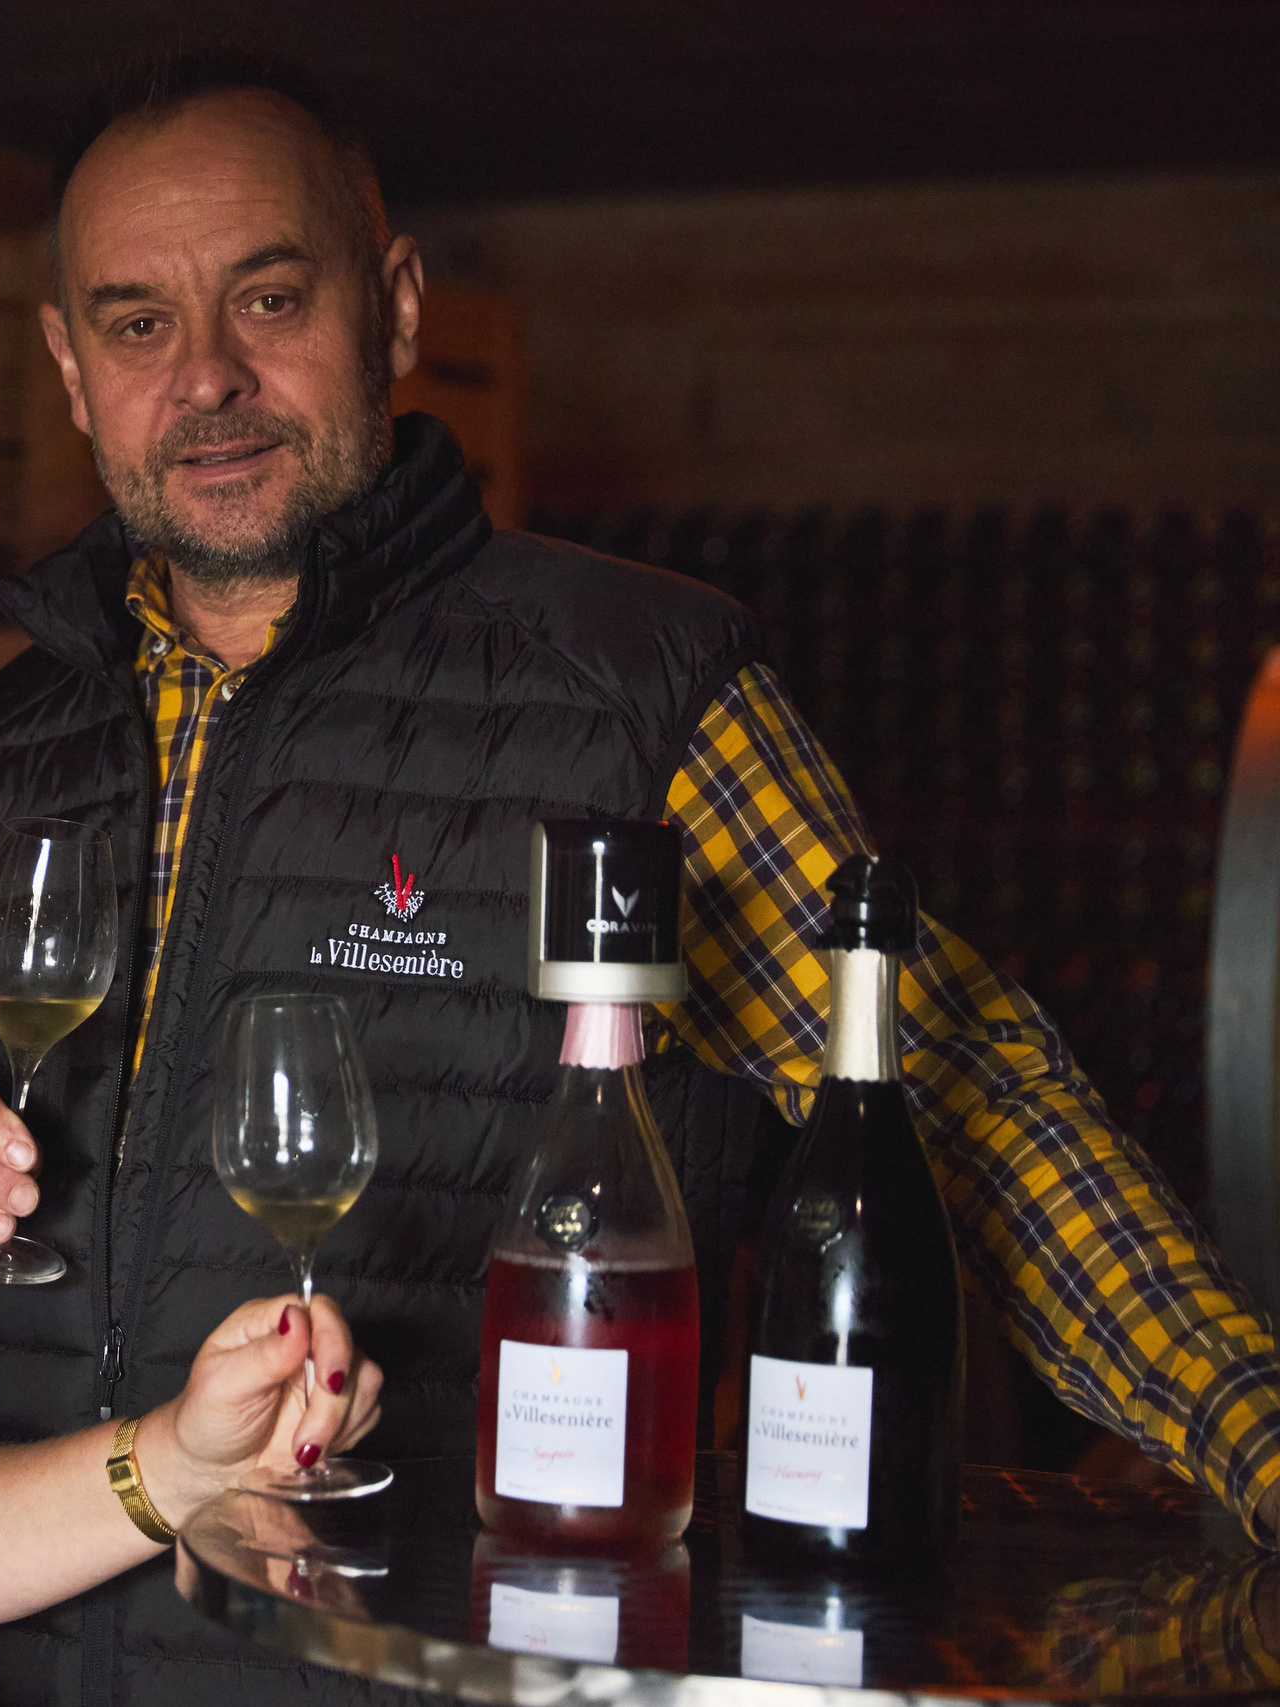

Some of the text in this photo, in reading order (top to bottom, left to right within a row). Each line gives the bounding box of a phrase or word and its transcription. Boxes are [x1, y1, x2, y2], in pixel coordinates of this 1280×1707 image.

[348, 923, 447, 945] CHAMPAGNE
[586, 919, 658, 934] CORAVIN
[309, 938, 464, 979] la Villesenière
[512, 1390, 603, 1406] CHAMPAGNE
[513, 1404, 614, 1429] Villesenière
[760, 1406, 848, 1425] CHAMPAGNE
[761, 1419, 859, 1448] Villesenière
